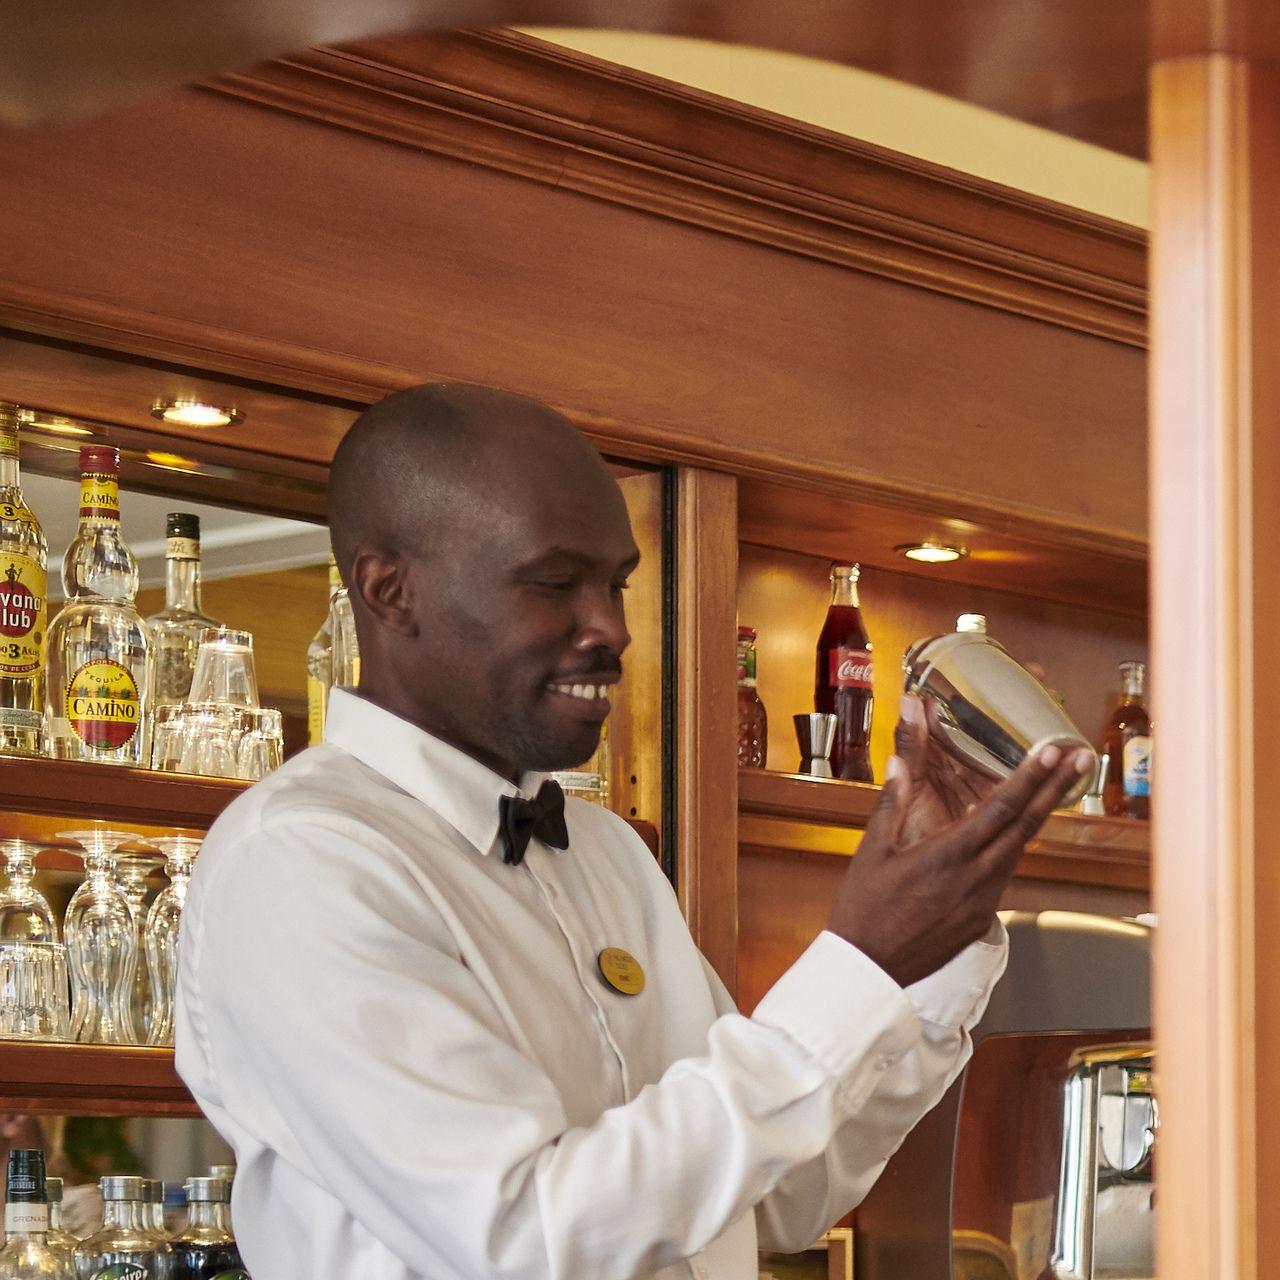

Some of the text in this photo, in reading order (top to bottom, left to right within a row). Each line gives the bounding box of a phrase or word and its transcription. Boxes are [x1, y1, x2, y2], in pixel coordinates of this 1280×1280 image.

[4, 506, 14, 516] 3
[9, 643, 20, 659] 3
[85, 671, 124, 684] TEQUILA
[73, 698, 135, 719] CAMINO
